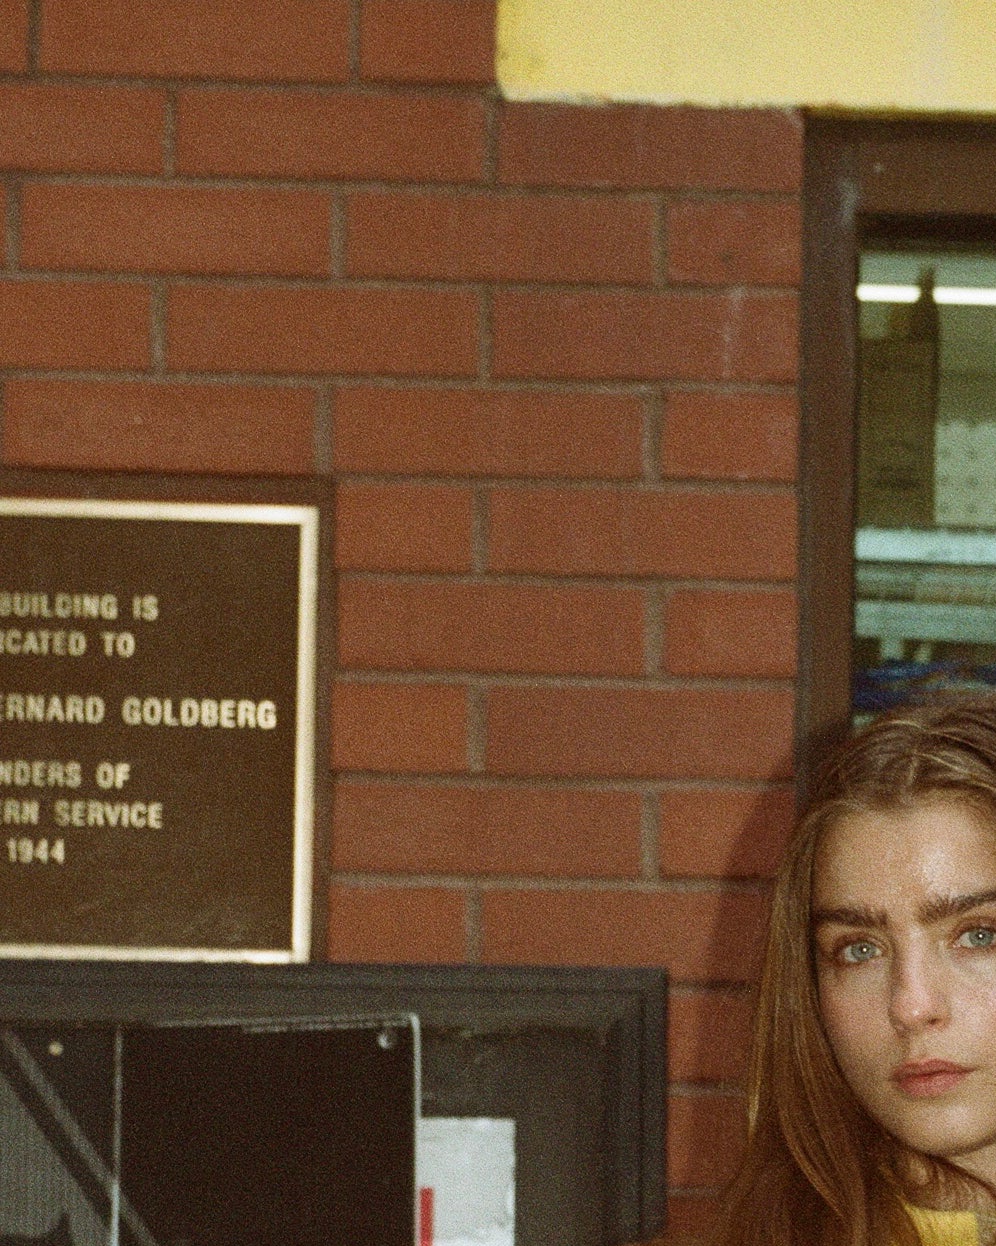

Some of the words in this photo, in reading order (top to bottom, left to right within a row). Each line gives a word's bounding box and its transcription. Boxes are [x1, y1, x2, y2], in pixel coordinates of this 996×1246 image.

[132, 594, 159, 622] IS
[103, 631, 136, 658] TO
[0, 693, 105, 724] RNARD
[121, 696, 278, 730] GOLDBERG
[96, 762, 131, 790] OF
[0, 798, 39, 826] RN
[54, 801, 163, 829] SERVICE
[7, 837, 66, 865] 1944
